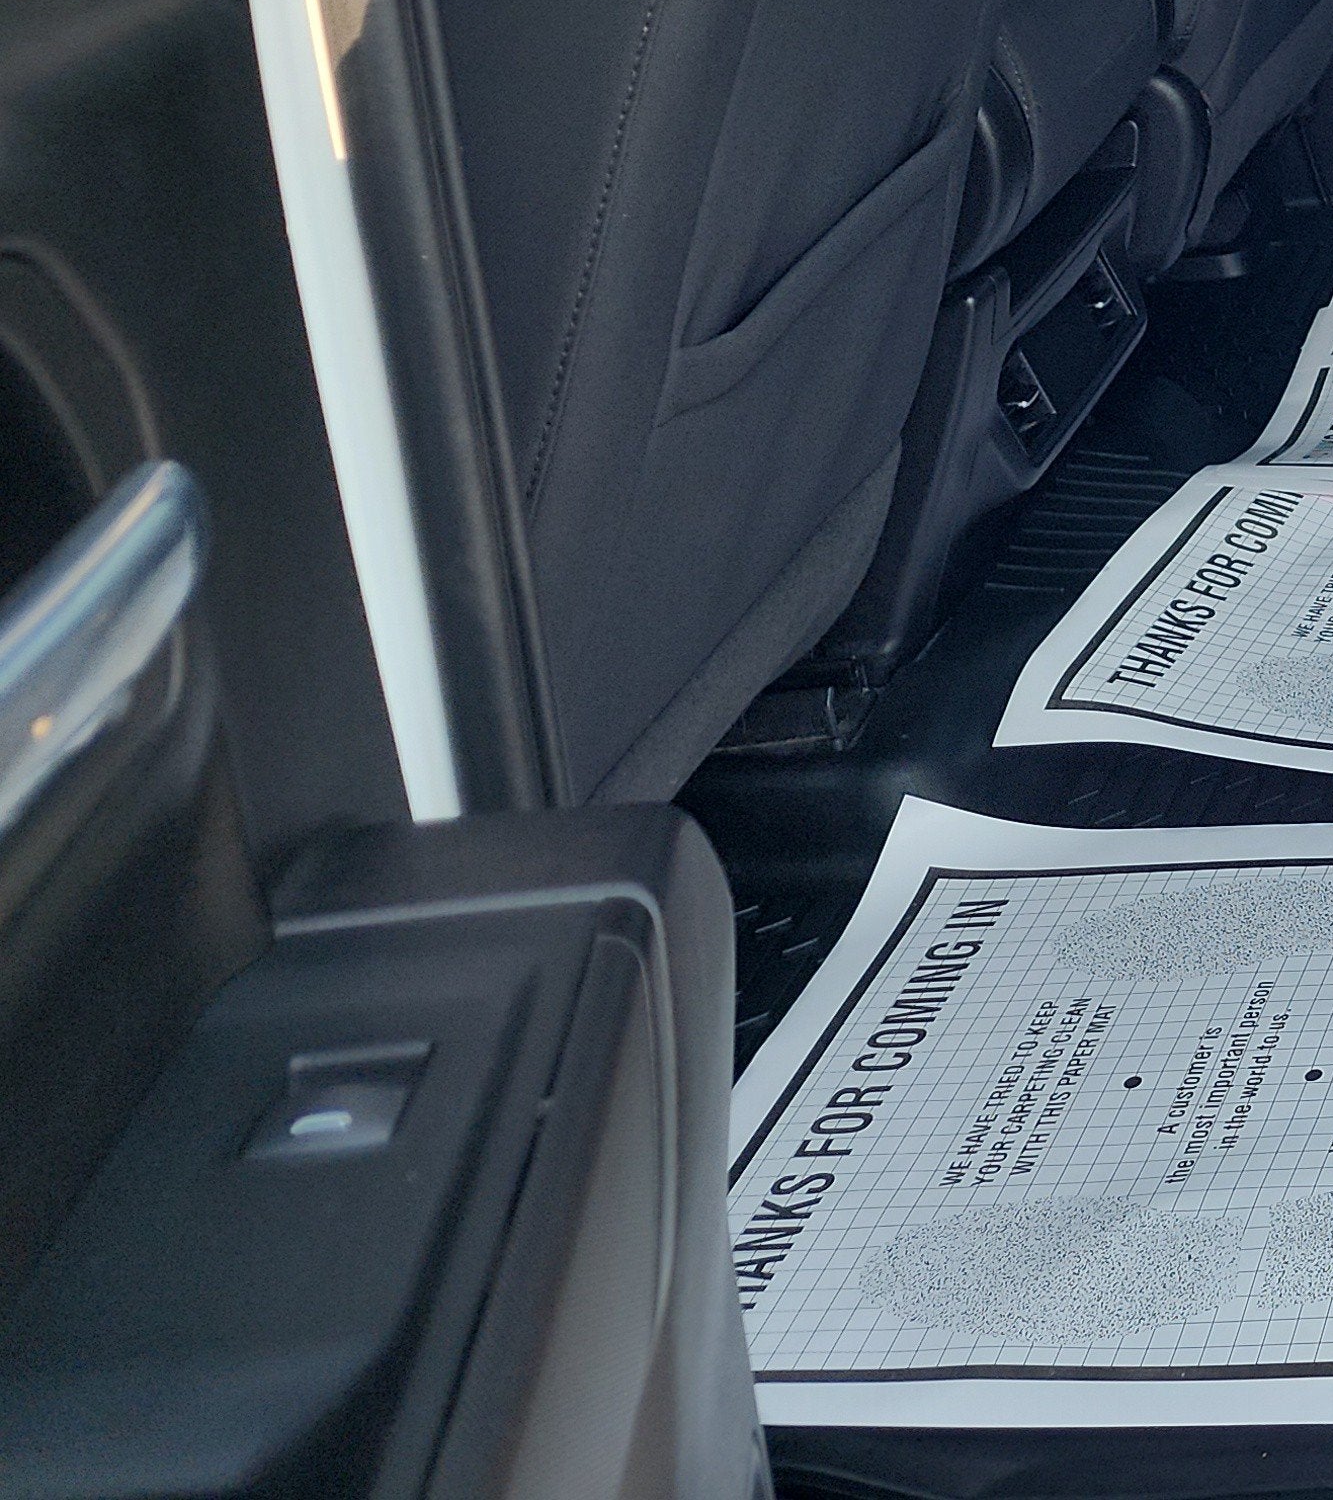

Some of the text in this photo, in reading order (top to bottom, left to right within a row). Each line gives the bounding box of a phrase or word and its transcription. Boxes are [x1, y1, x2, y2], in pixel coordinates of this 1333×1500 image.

[1106, 599, 1216, 688] THANKS
[1185, 553, 1254, 601] FOR
[1291, 623, 1314, 638] WE
[1303, 596, 1332, 622] HAVE
[793, 1084, 894, 1159] FOR
[853, 938, 985, 1073] COMING
[945, 898, 1010, 929] IN
[1010, 1003, 1118, 1176] WITH THIS PAPER MAT
[1157, 1025, 1224, 1136] A customer is
[1164, 980, 1275, 1185] the most important person
[1240, 1055, 1273, 1101] world
[1257, 1035, 1281, 1051] to
[938, 1000, 1060, 1187] WE HAVE TRIED TO KEEP
[970, 997, 1093, 1188] YOUR CARPETING CLEAN
[1213, 1134, 1241, 1151] in
[1223, 1103, 1252, 1131] the
